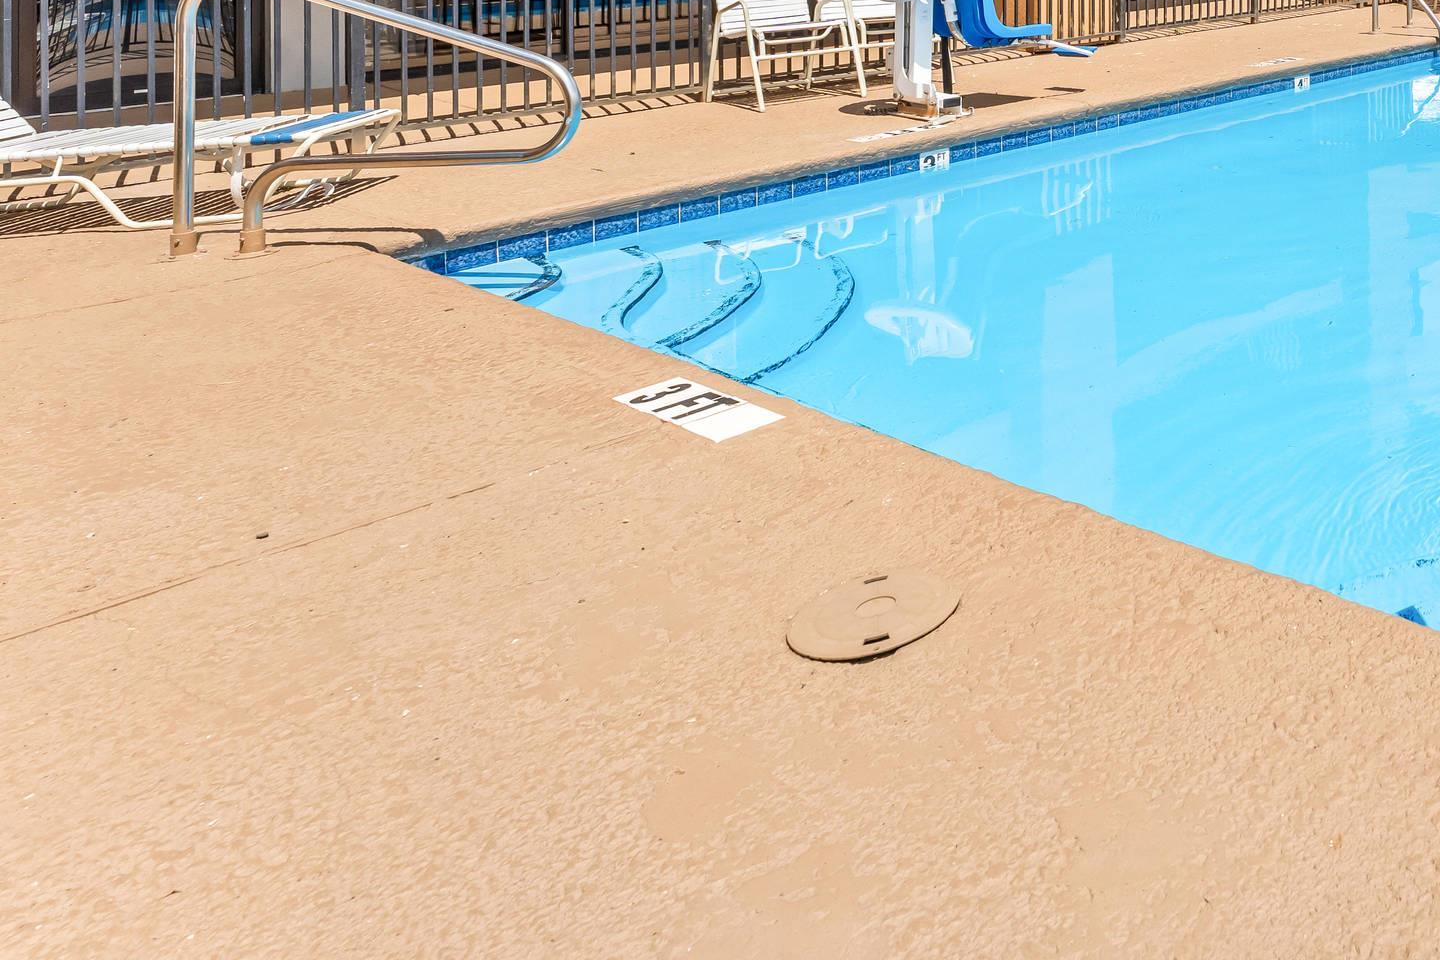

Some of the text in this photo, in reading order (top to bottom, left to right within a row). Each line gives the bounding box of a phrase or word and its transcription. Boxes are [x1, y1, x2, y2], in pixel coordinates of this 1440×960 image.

[936, 152, 948, 161] FT
[629, 383, 741, 420] 3 FT
